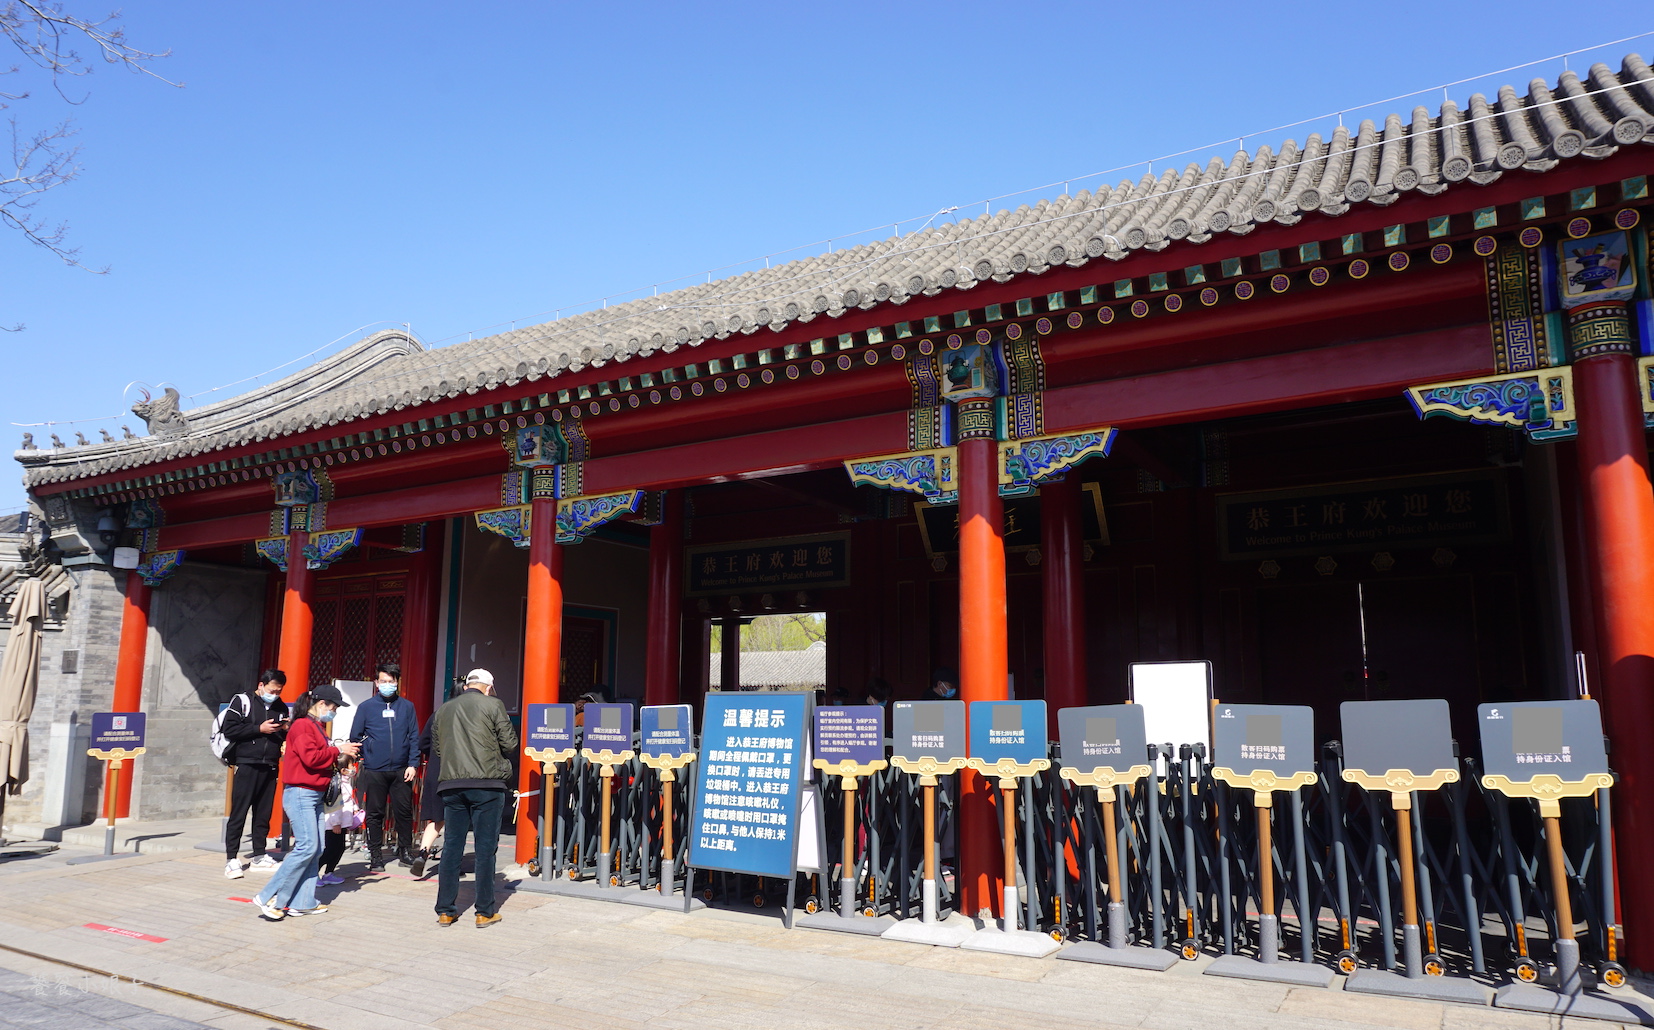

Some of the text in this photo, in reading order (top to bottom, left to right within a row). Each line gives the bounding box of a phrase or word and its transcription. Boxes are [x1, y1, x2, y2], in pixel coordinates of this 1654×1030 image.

[1246, 489, 1472, 531] 恭王府欢迎您
[1246, 519, 1476, 546] Welcome to Prince Kung's Palace Museum
[702, 546, 833, 575] 恭王府欢迎您
[701, 570, 833, 587] Welcome to Prince Kung's Palace Museum
[723, 709, 785, 728] 温馨提示
[726, 736, 793, 750] 进入恭王府博物馆
[1083, 747, 1121, 755] 持身份证入馆
[1241, 744, 1285, 753] 散客扫码购票
[709, 750, 792, 765] 期间全程佩戴口罩，更
[1241, 752, 1285, 761] 持身份证入馆
[1516, 755, 1571, 763] 持身份证入馆
[707, 764, 790, 779] 换口罩时，请丢进专用
[705, 778, 789, 795] 垃圾桶中。进入恭王府
[704, 793, 785, 810] 博物馆注意咳嗽礼仪，
[703, 808, 787, 826] 咳嗽或喷嚏时用口罩掩
[700, 837, 737, 852] 以上距离。
